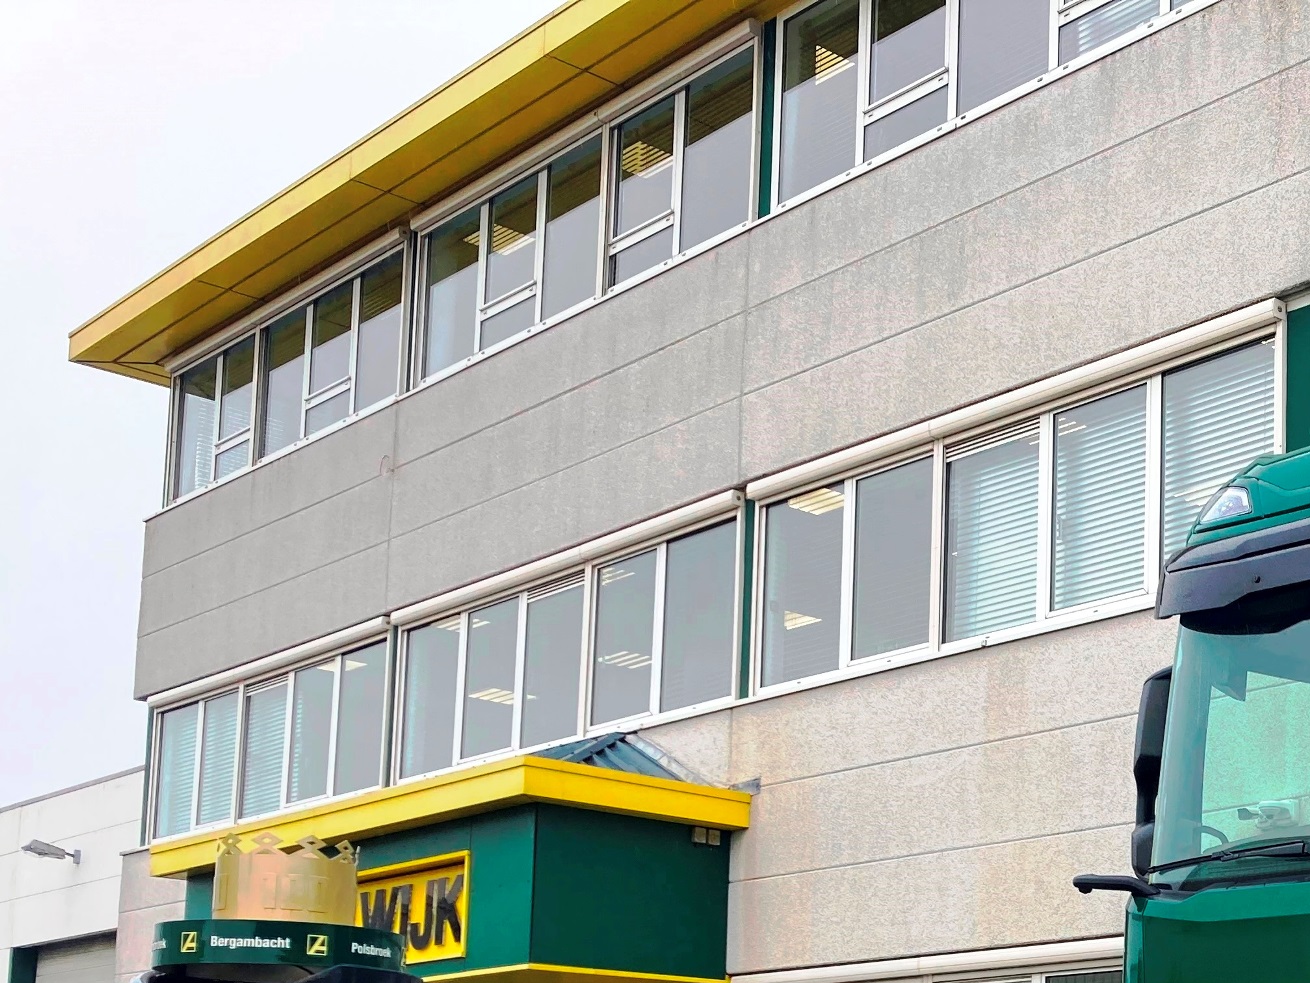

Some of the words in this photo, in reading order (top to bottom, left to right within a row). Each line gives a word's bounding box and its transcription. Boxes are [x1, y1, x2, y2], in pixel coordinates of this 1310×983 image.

[360, 874, 464, 950] WIJK
[210, 935, 291, 949] Bergambacht
[350, 942, 392, 958] Polsbroek
